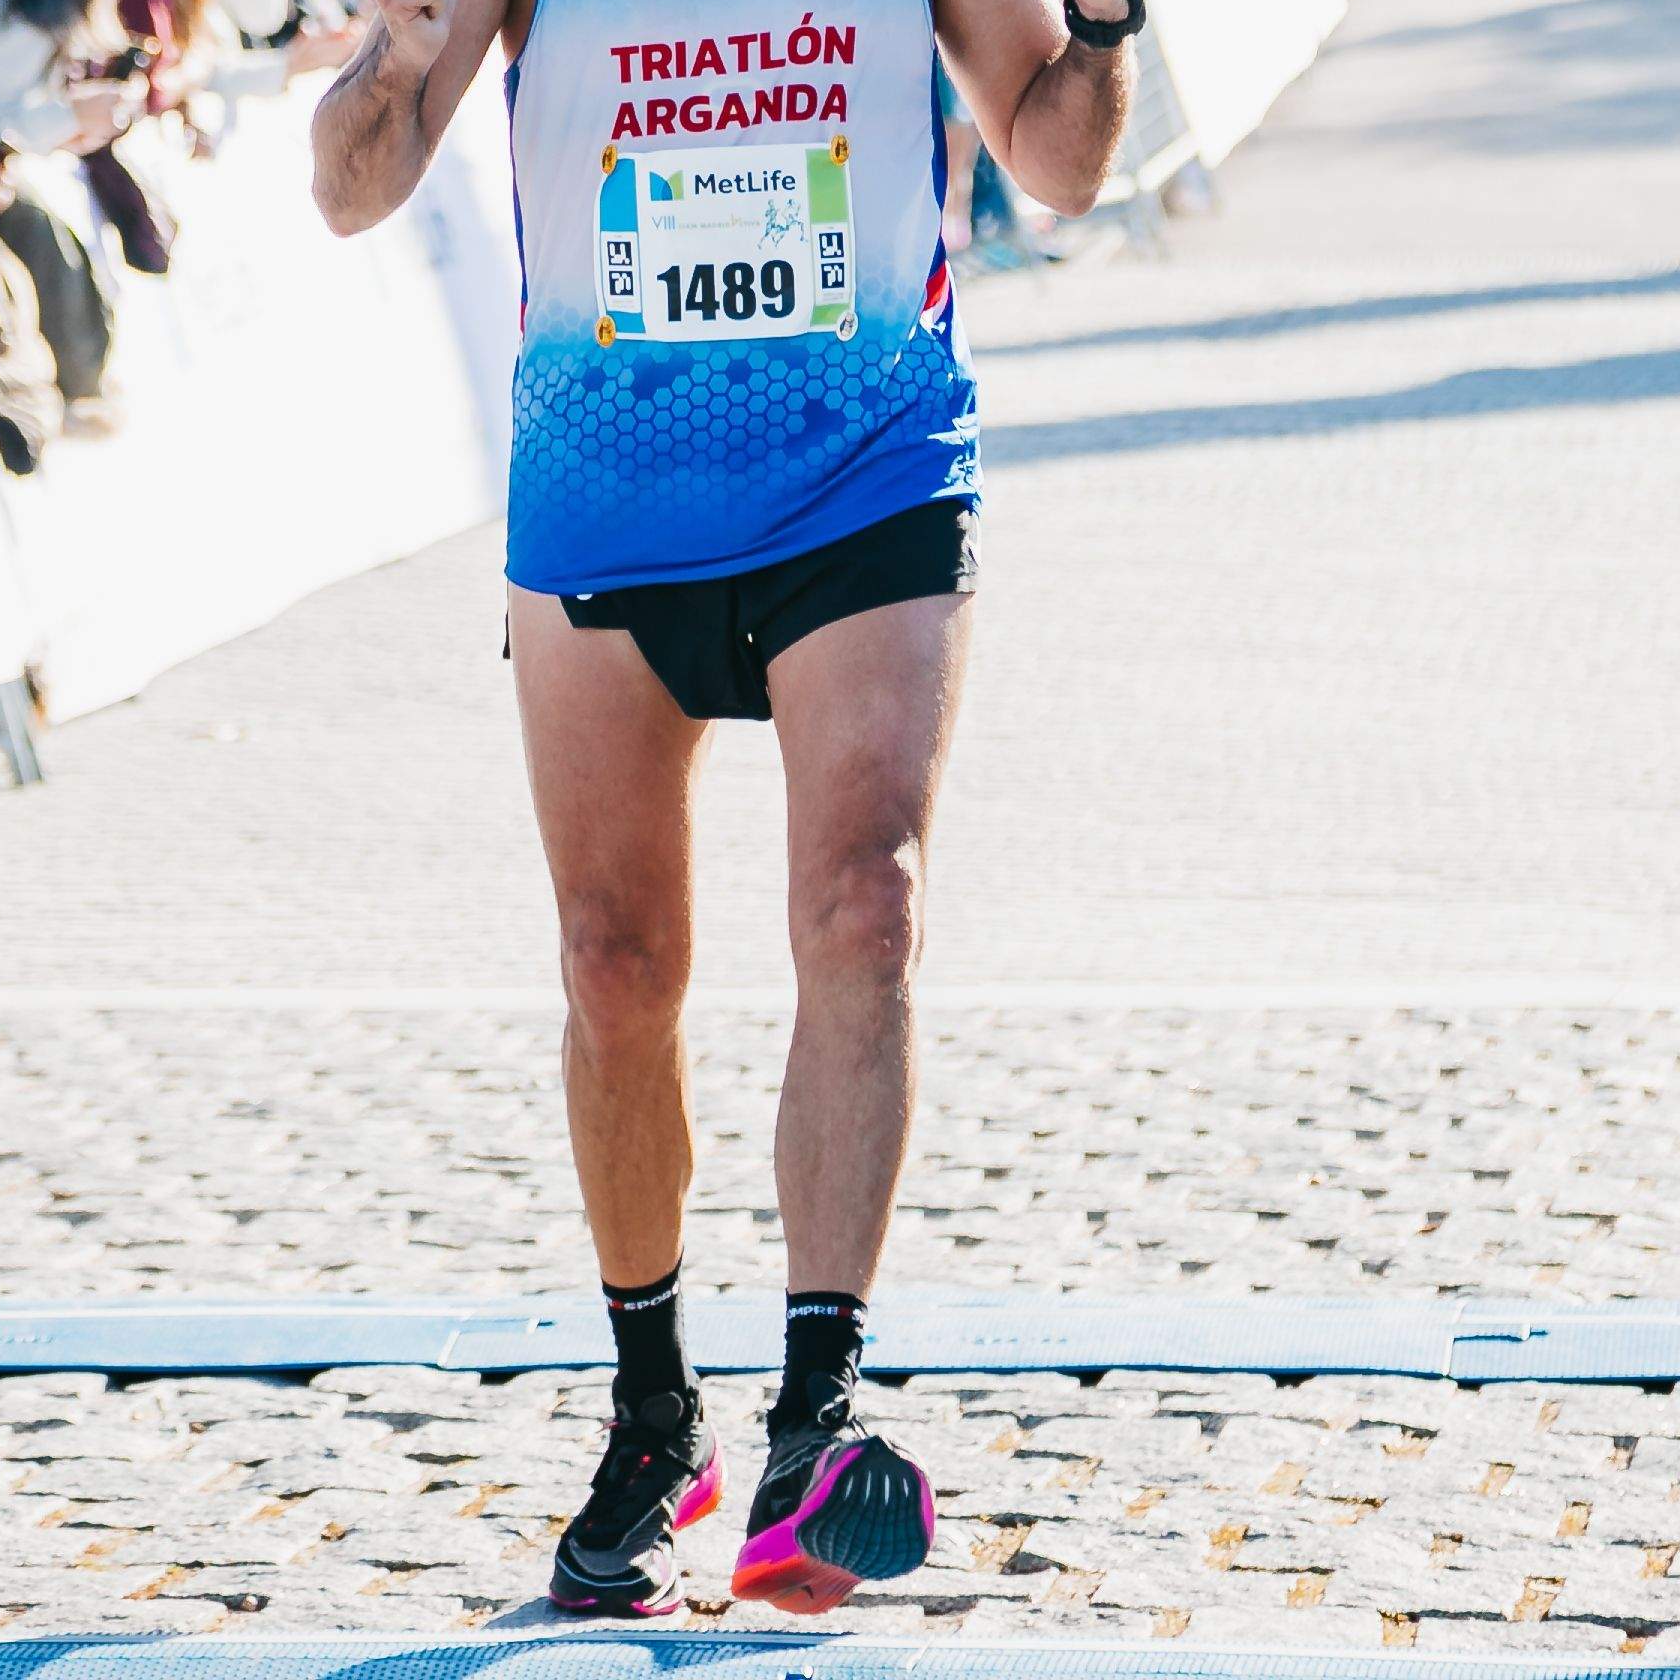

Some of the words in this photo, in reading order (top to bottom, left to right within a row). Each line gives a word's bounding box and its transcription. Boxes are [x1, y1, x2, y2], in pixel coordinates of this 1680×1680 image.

[610, 12, 857, 84] TRIATLÓN
[610, 83, 848, 140] ARGANDA
[693, 169, 796, 195] MetLife
[651, 215, 675, 232] VIII
[656, 258, 796, 323] 1489
